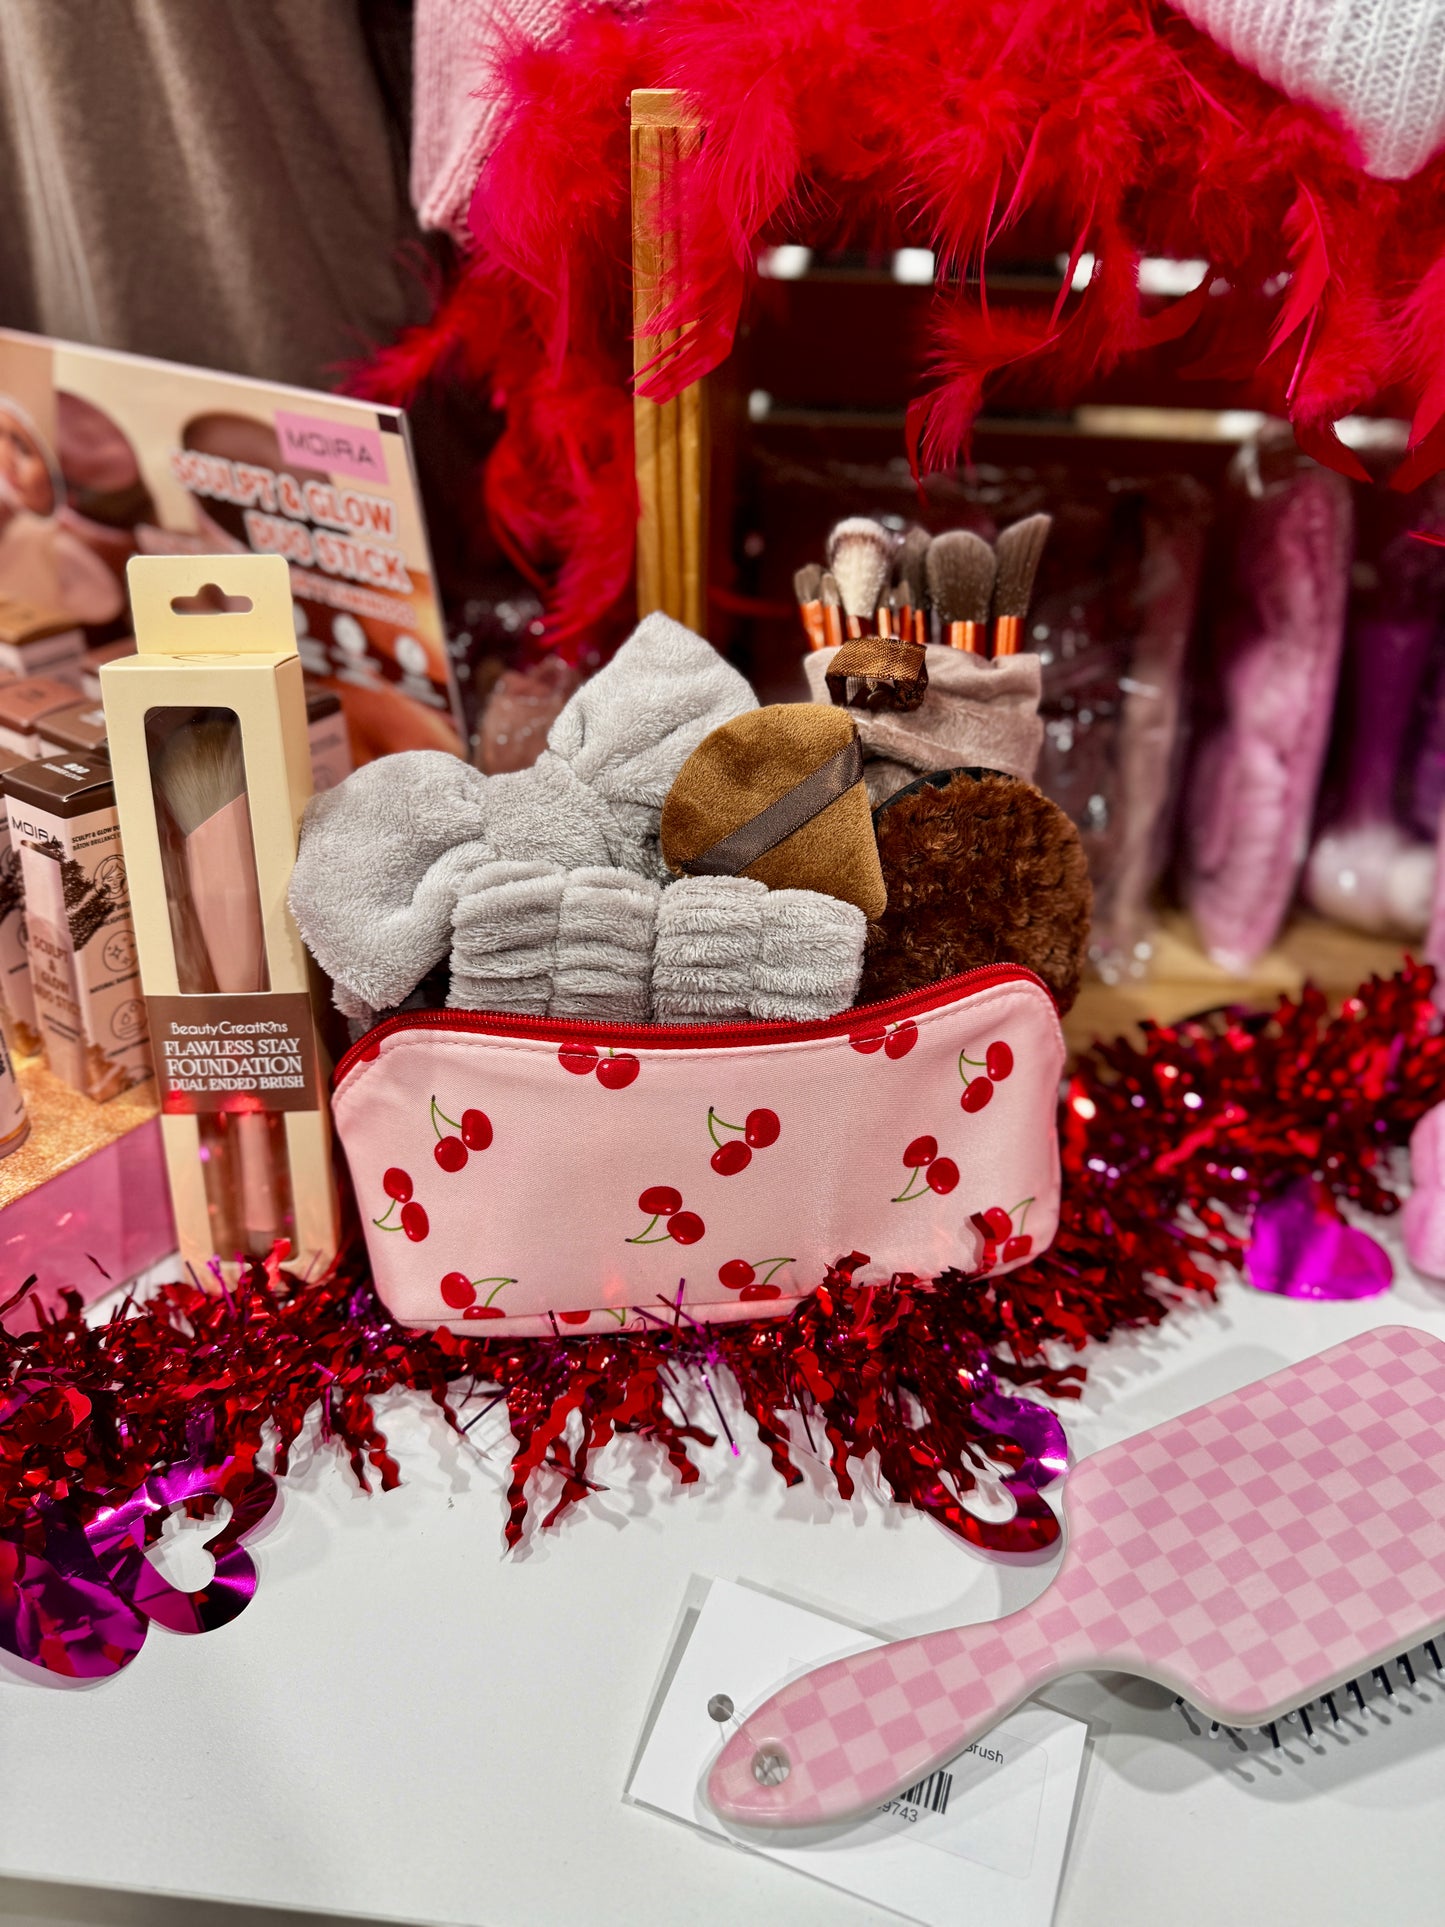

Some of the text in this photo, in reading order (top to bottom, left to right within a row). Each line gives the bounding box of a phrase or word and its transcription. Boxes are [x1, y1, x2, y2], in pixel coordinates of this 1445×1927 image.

[285, 428, 376, 466] MOIRA
[279, 475, 306, 518] &
[306, 482, 395, 540] GLOW
[314, 531, 411, 592] STICK
[12, 816, 60, 845] MOIRA
[72, 832, 92, 843] SCULPT
[97, 827, 112, 836] GLOW
[164, 1040, 254, 1055] FLAWLESS
[258, 1038, 300, 1054] STAY
[166, 1056, 302, 1076] FOUNDATION
[170, 1075, 304, 1091] DUAL ENDED BRUSH
[878, 1800, 918, 1823] 9743
